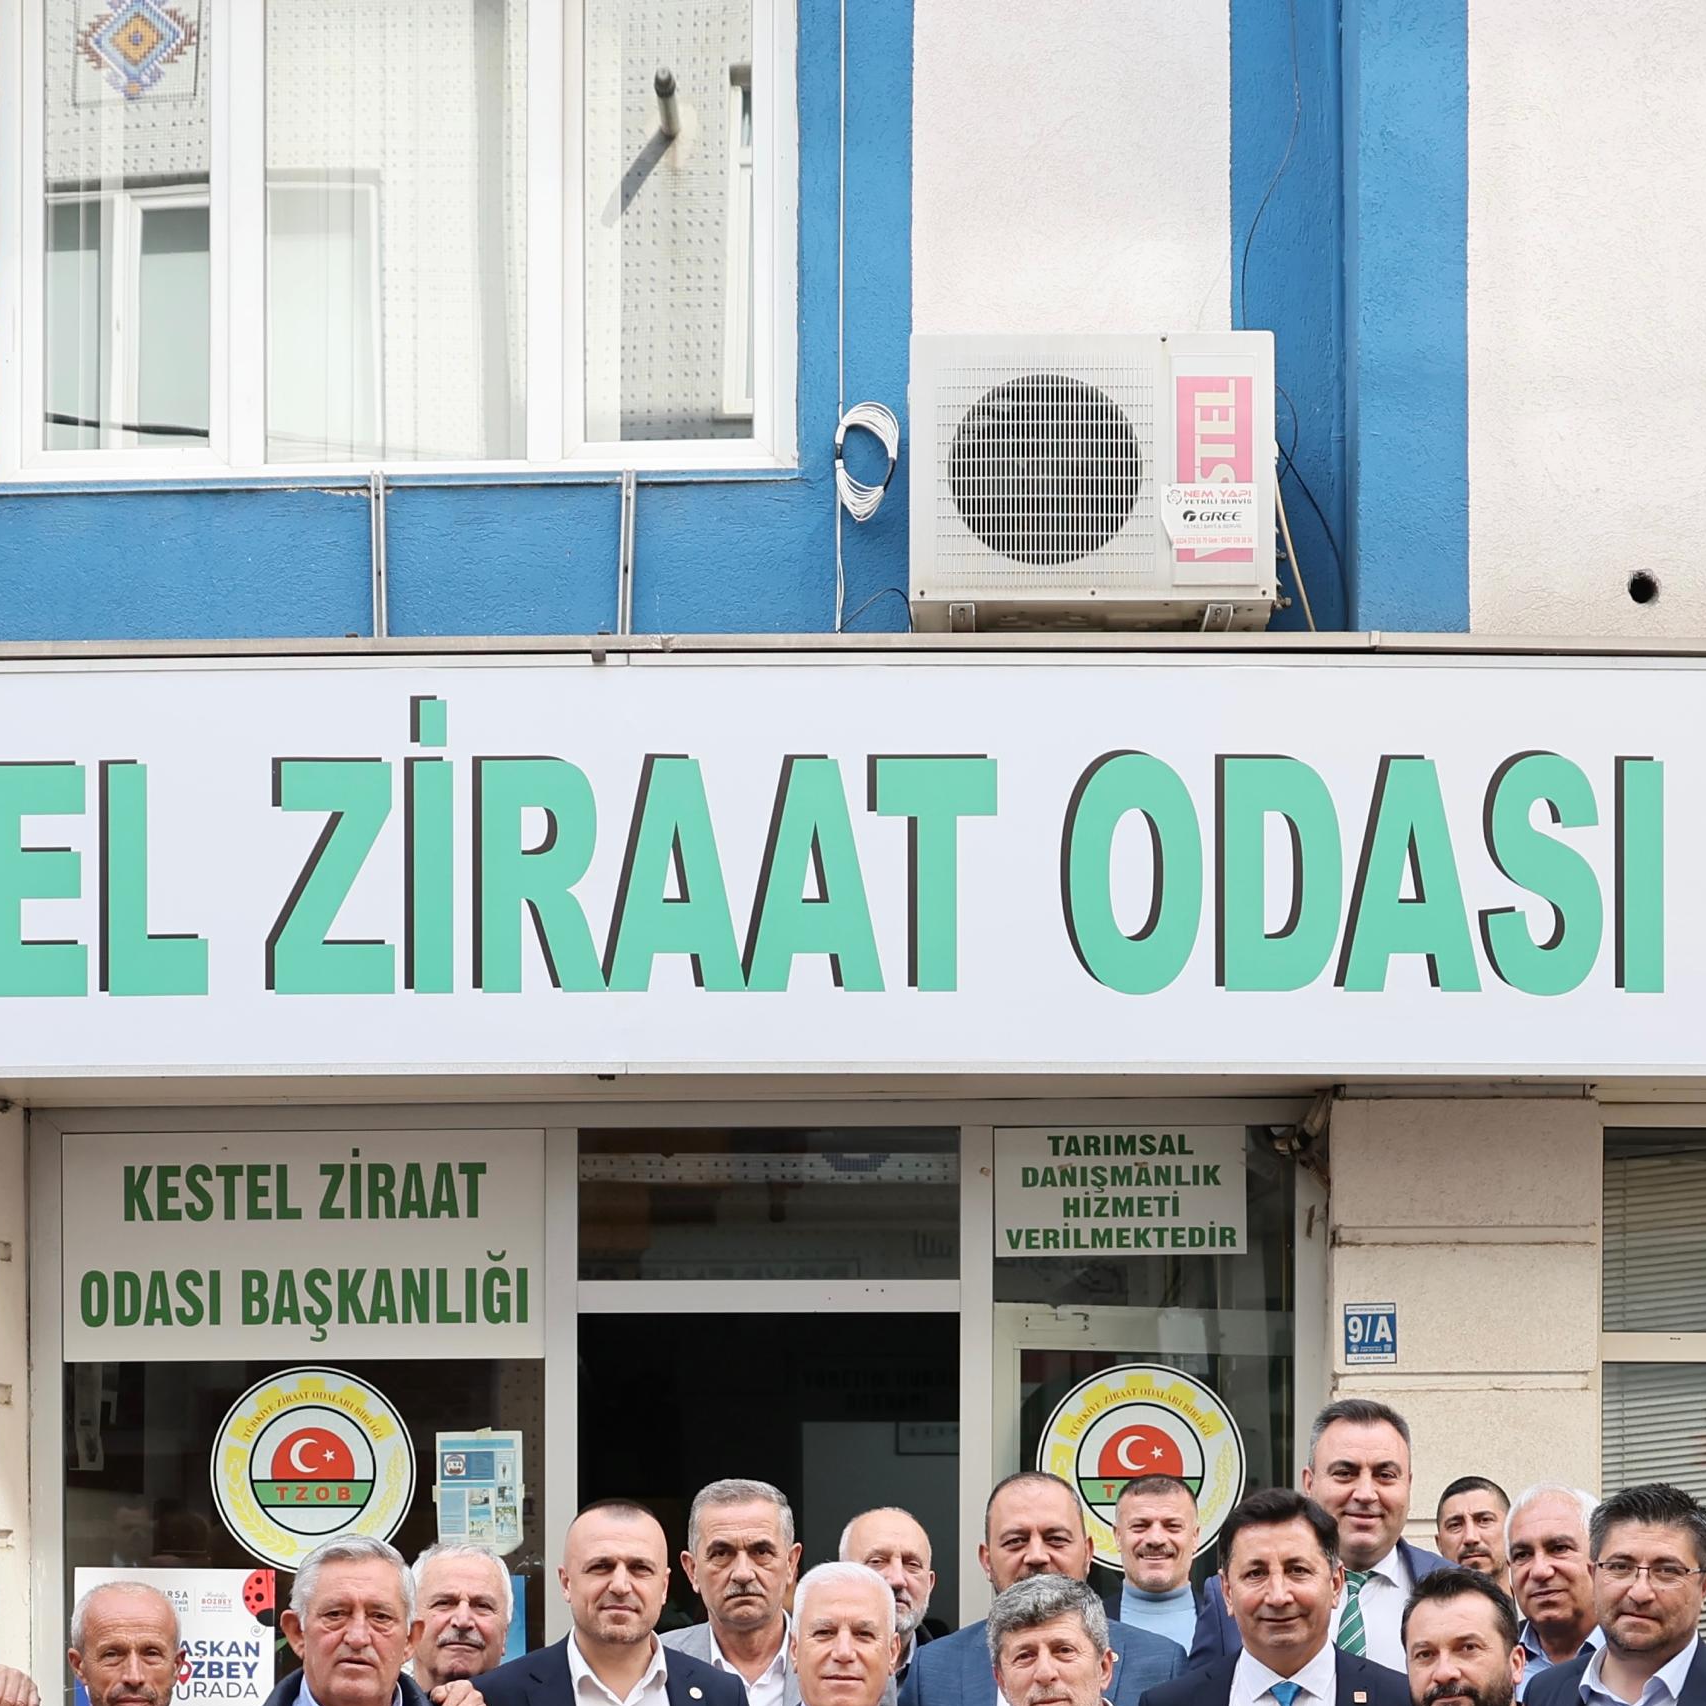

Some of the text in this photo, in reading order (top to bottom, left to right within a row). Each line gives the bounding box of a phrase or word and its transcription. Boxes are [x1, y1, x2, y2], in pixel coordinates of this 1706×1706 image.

[1199, 511, 1242, 522] GREE
[265, 695, 999, 996] ZİRAAT
[1059, 748, 1666, 997] ODASI
[1047, 1134, 1194, 1156] TARIMSAL
[123, 1147, 487, 1222] KESTEL ZİRAAT
[1021, 1164, 1221, 1193] DANIŞMANLIK
[1063, 1190, 1180, 1218] HİZMETİ
[1006, 1221, 1237, 1250] VERİLMEKTEDİR
[80, 1250, 529, 1342] ODASI BAŞKANLIĞI
[1348, 1315, 1393, 1343] 9/A
[243, 1406, 276, 1439] TÜRKİYE
[276, 1391, 309, 1407] ZİRAAT
[1069, 1403, 1101, 1436] TÜRKİYE
[1103, 1387, 1138, 1404] ZİRAAT
[276, 1486, 351, 1500] TZOB
[180, 1640, 260, 1659] AŞKAN
[176, 1682, 259, 1700] URADA
